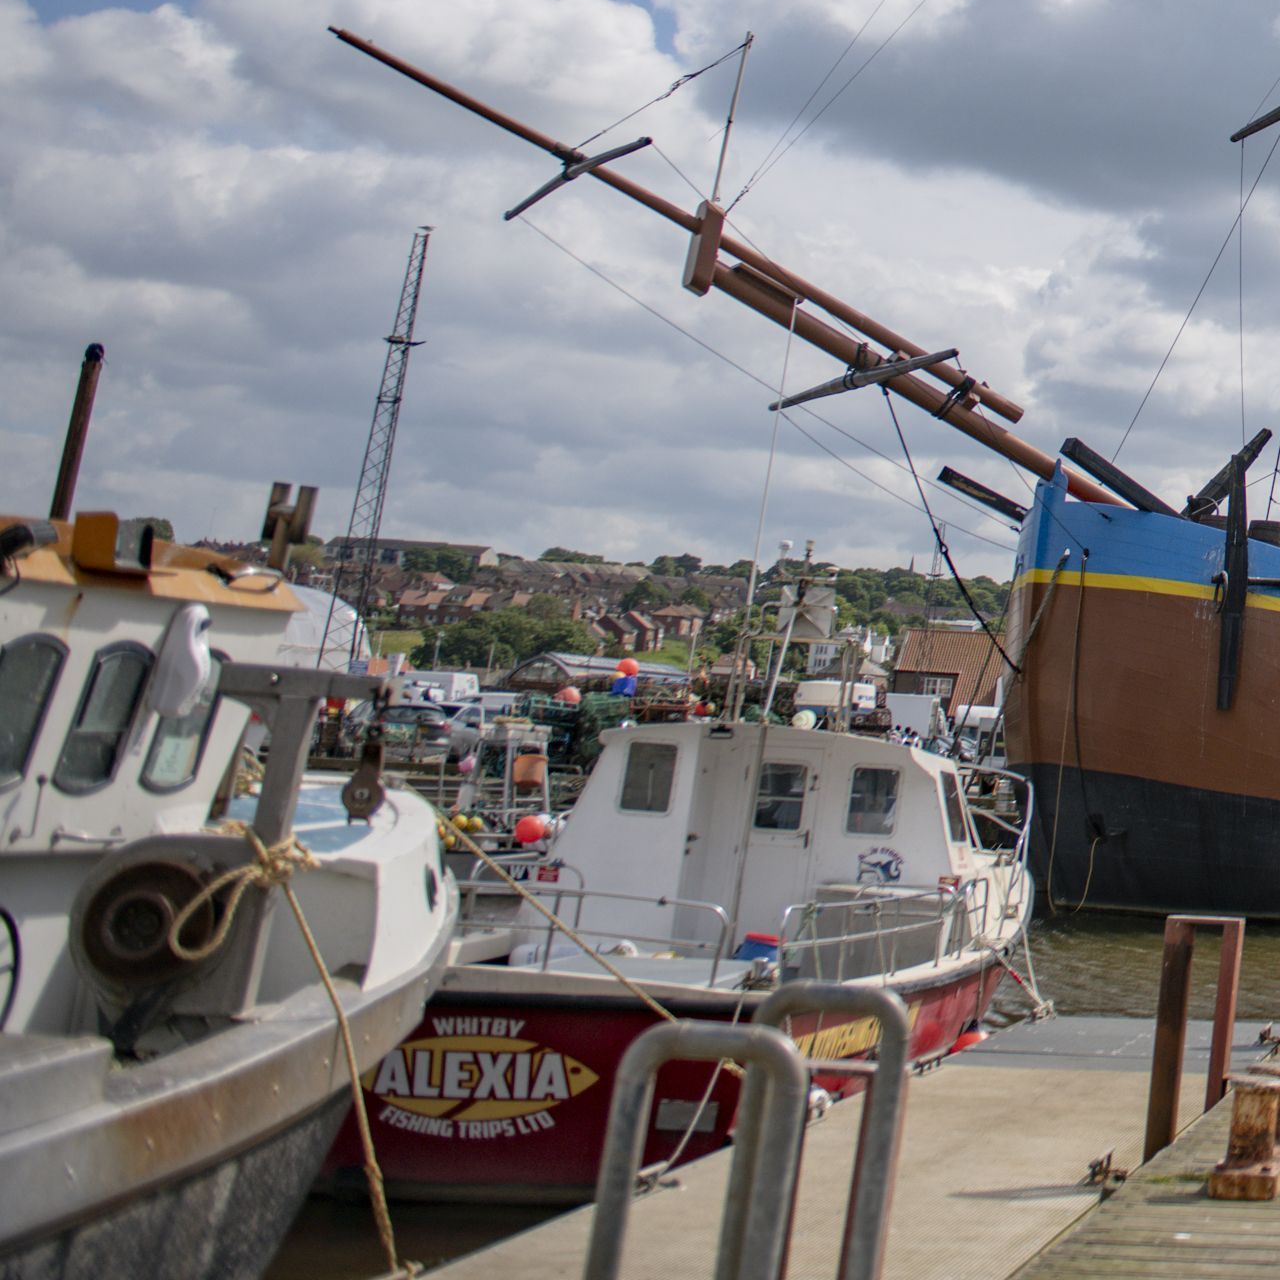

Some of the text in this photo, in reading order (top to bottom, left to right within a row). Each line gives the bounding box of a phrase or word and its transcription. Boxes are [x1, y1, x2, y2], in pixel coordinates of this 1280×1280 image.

[432, 1016, 526, 1038] WHITBY
[373, 1049, 570, 1100] ALEXIA
[379, 1104, 555, 1139] FISHING TRIPS LTD
